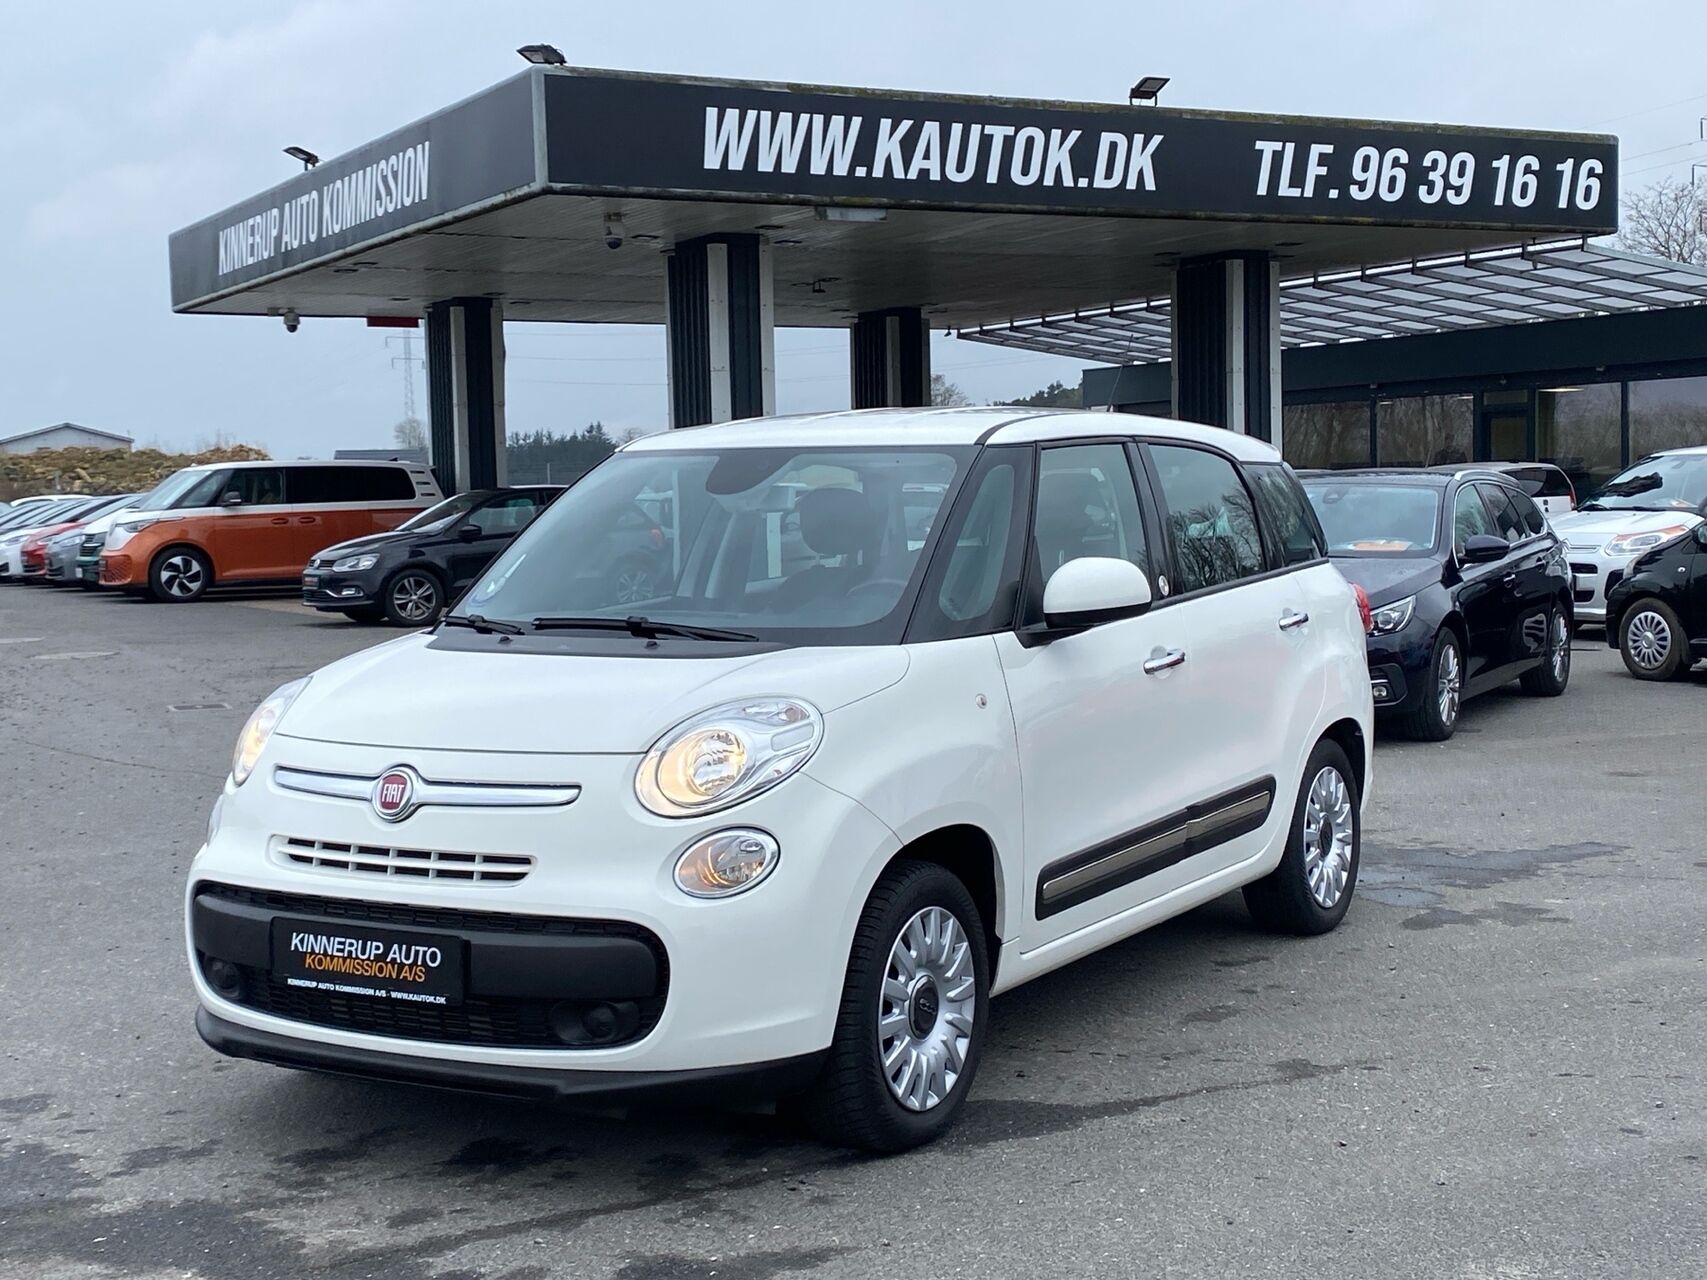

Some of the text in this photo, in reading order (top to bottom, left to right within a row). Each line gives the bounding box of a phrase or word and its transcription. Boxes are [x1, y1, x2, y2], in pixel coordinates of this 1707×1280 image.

[703, 106, 1164, 191] WWW.KAUTOK.DK
[1254, 140, 1604, 211] TLF. 96 39 16 16
[218, 141, 430, 276] KINNERUP AUTO KOMMISSION
[381, 783, 405, 803] FIAT
[290, 932, 442, 968] KINNERUP AUTO
[304, 954, 426, 982] KOMMISSION A/S
[317, 982, 335, 991] AUTO
